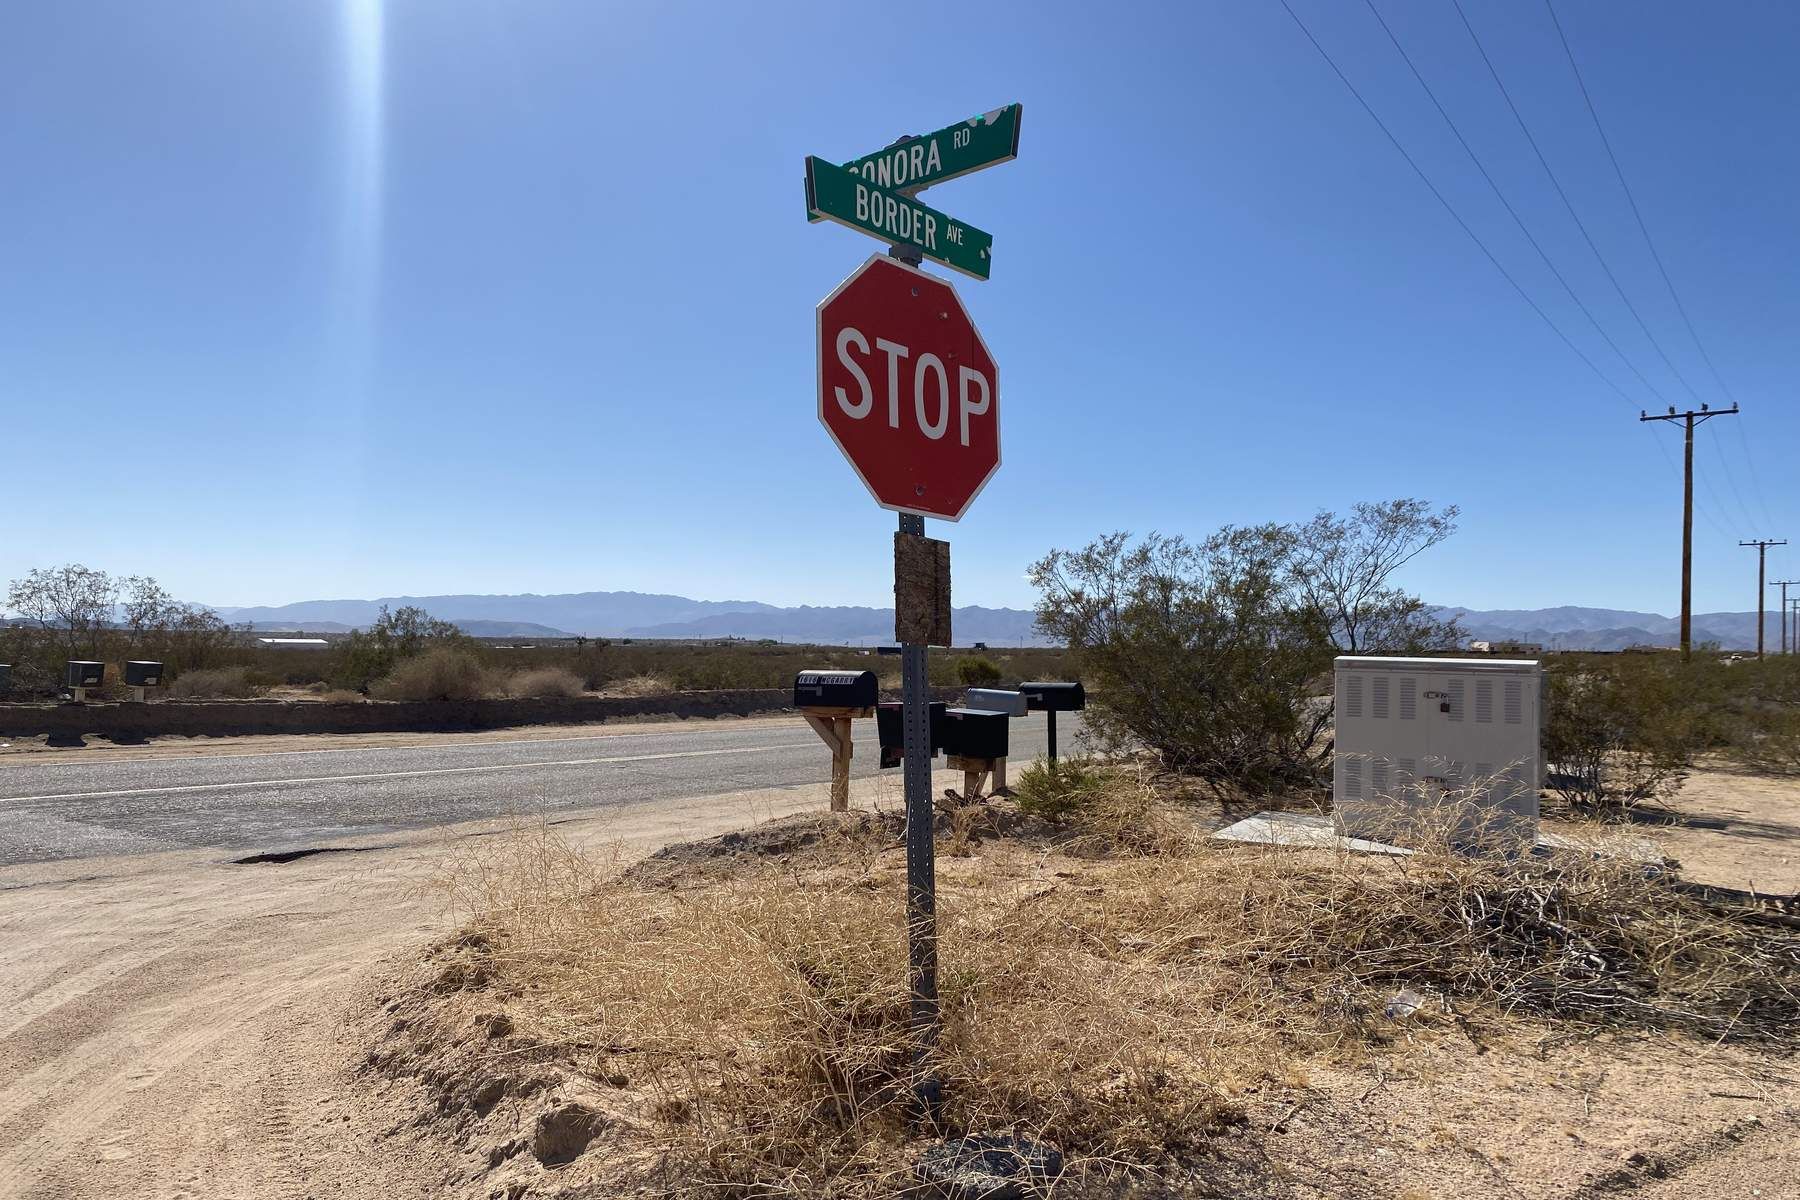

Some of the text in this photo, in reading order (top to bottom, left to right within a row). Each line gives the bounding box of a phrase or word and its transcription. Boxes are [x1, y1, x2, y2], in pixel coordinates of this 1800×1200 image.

[849, 128, 970, 188] ONORA RD
[856, 183, 964, 250] BORDER AVE
[834, 327, 990, 447] STOP
